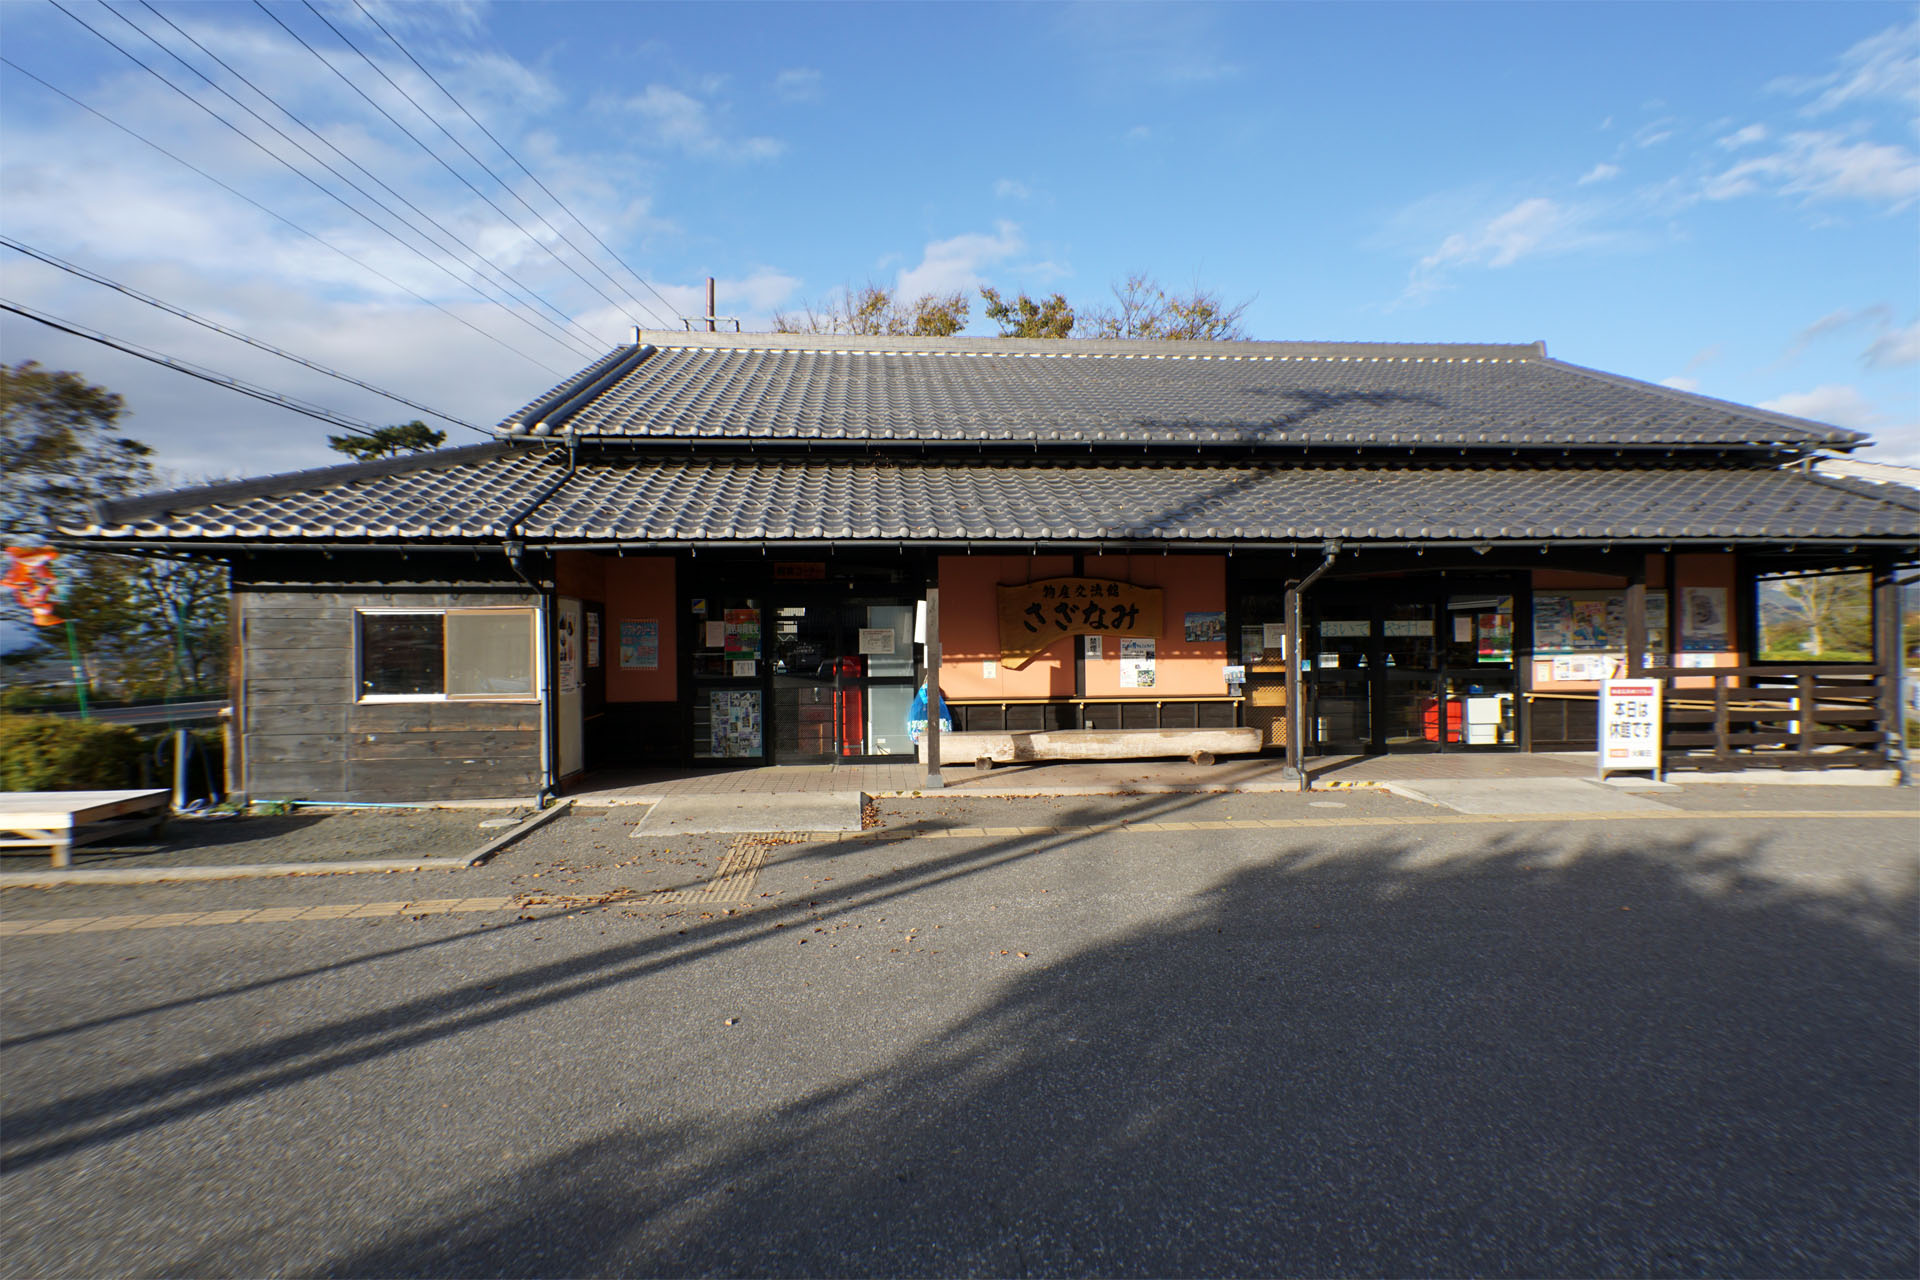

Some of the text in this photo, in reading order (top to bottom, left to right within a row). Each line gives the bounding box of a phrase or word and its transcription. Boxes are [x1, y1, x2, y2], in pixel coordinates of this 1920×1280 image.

[1043, 584, 1120, 599] 物産交流館
[1024, 601, 1140, 633] さざなみ
[1614, 701, 1648, 718] 本日は
[1610, 721, 1653, 737] 休館です
